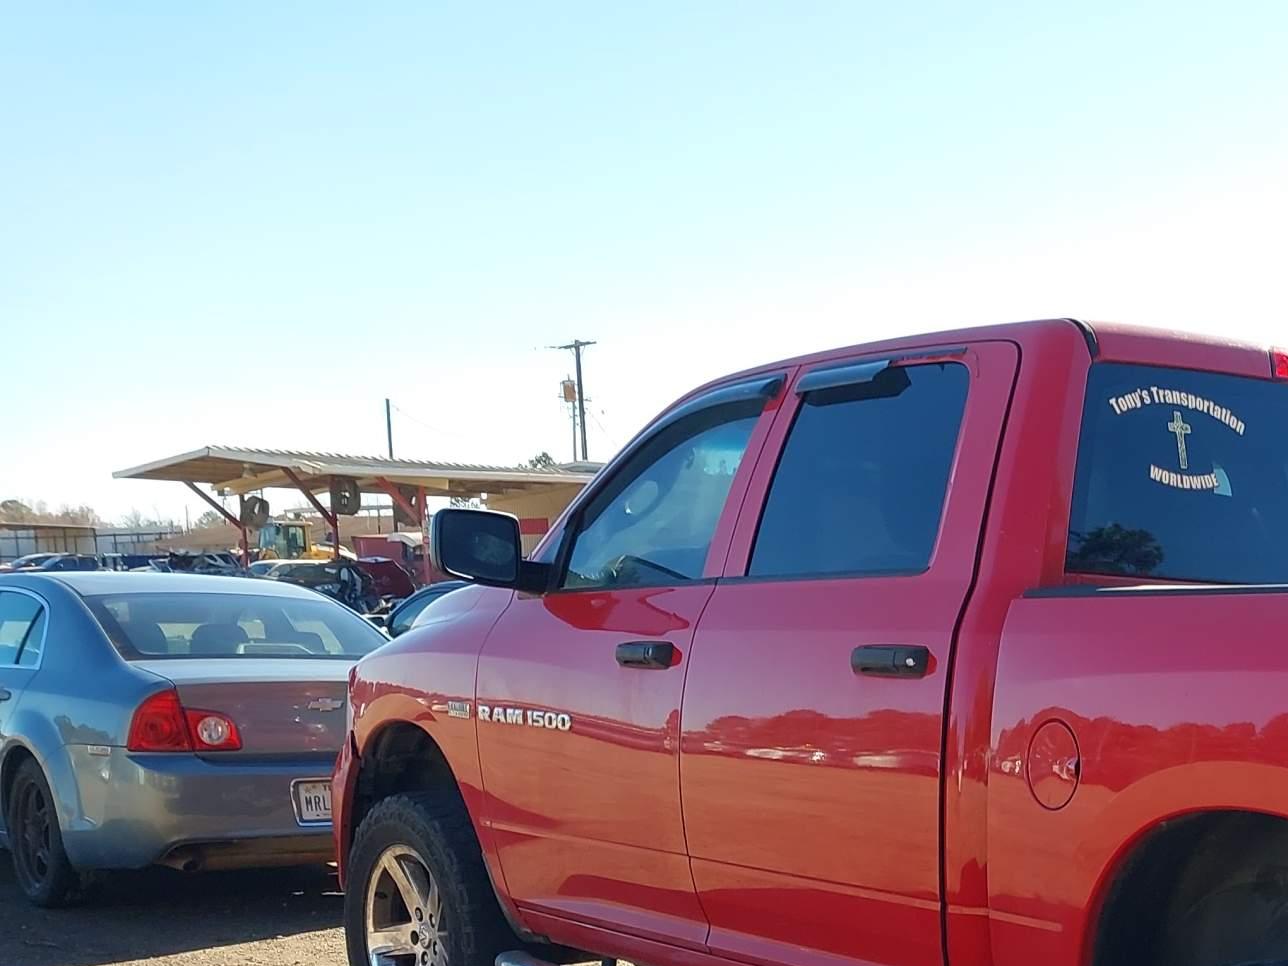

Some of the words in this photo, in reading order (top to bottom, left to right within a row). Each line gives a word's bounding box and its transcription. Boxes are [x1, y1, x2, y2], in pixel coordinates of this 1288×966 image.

[1109, 388, 1150, 415] Tony's
[1150, 386, 1246, 436] Transportation
[1150, 463, 1219, 489] WORLDWIDE
[477, 704, 524, 725] RAM
[526, 710, 572, 731] 1500
